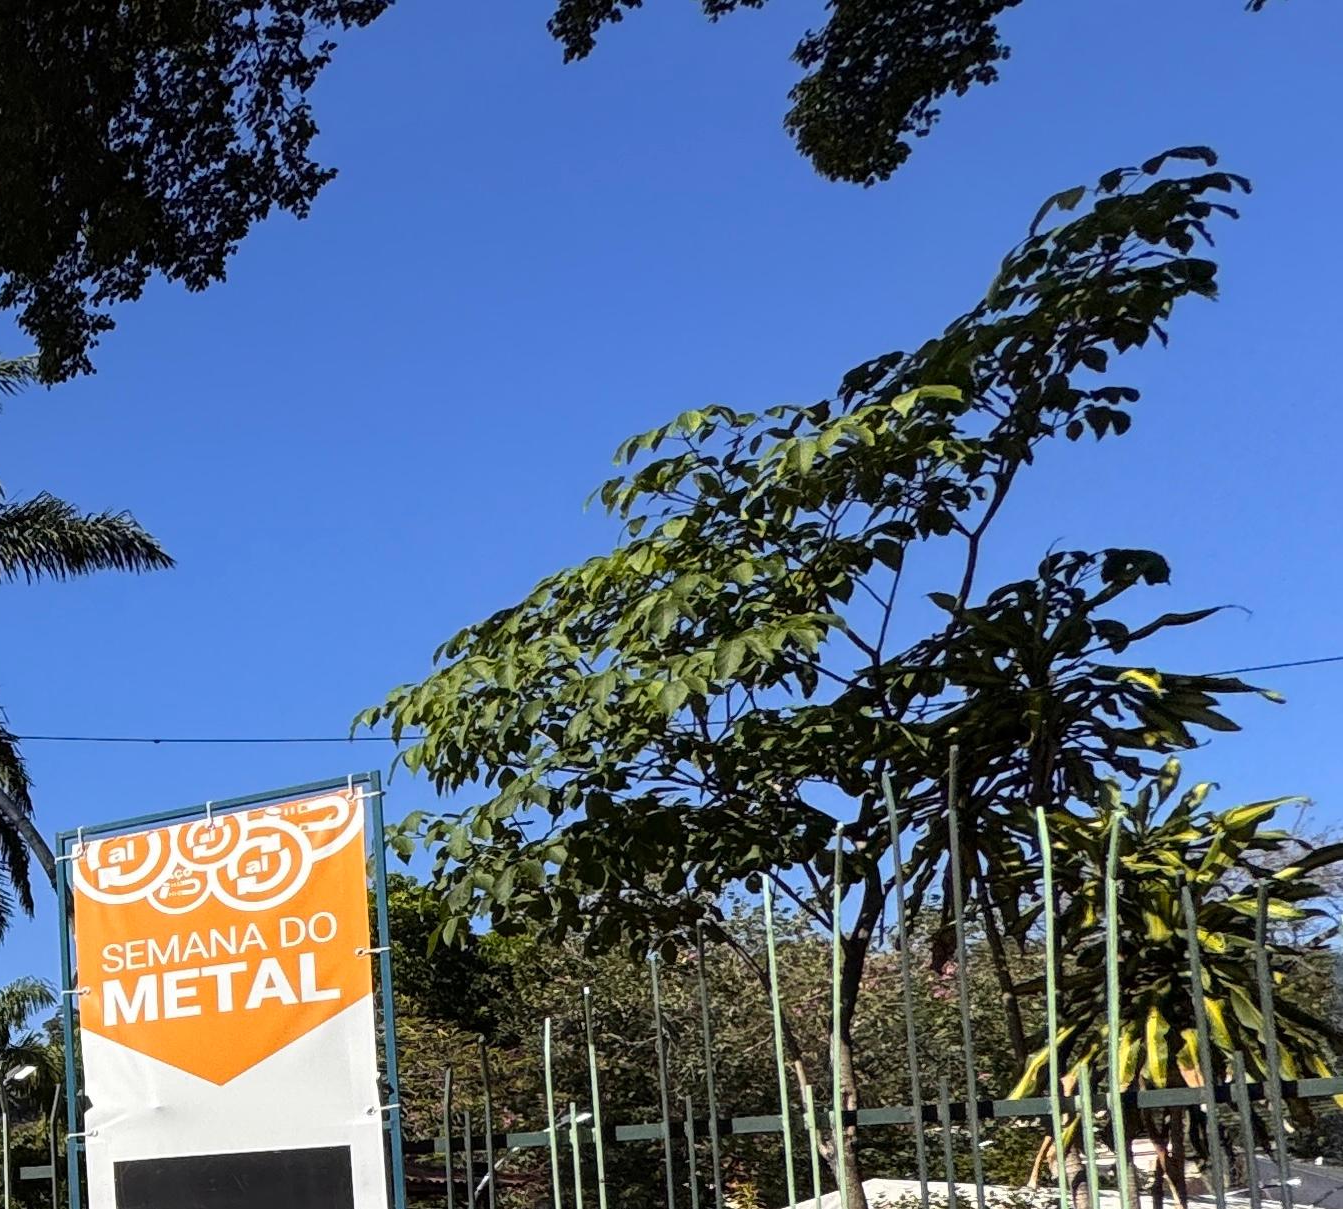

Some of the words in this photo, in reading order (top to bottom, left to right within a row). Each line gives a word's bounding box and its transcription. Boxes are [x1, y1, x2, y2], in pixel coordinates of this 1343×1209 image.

[101, 922, 268, 974] SEMANA
[279, 911, 337, 948] DO
[102, 952, 341, 1027] METAL
